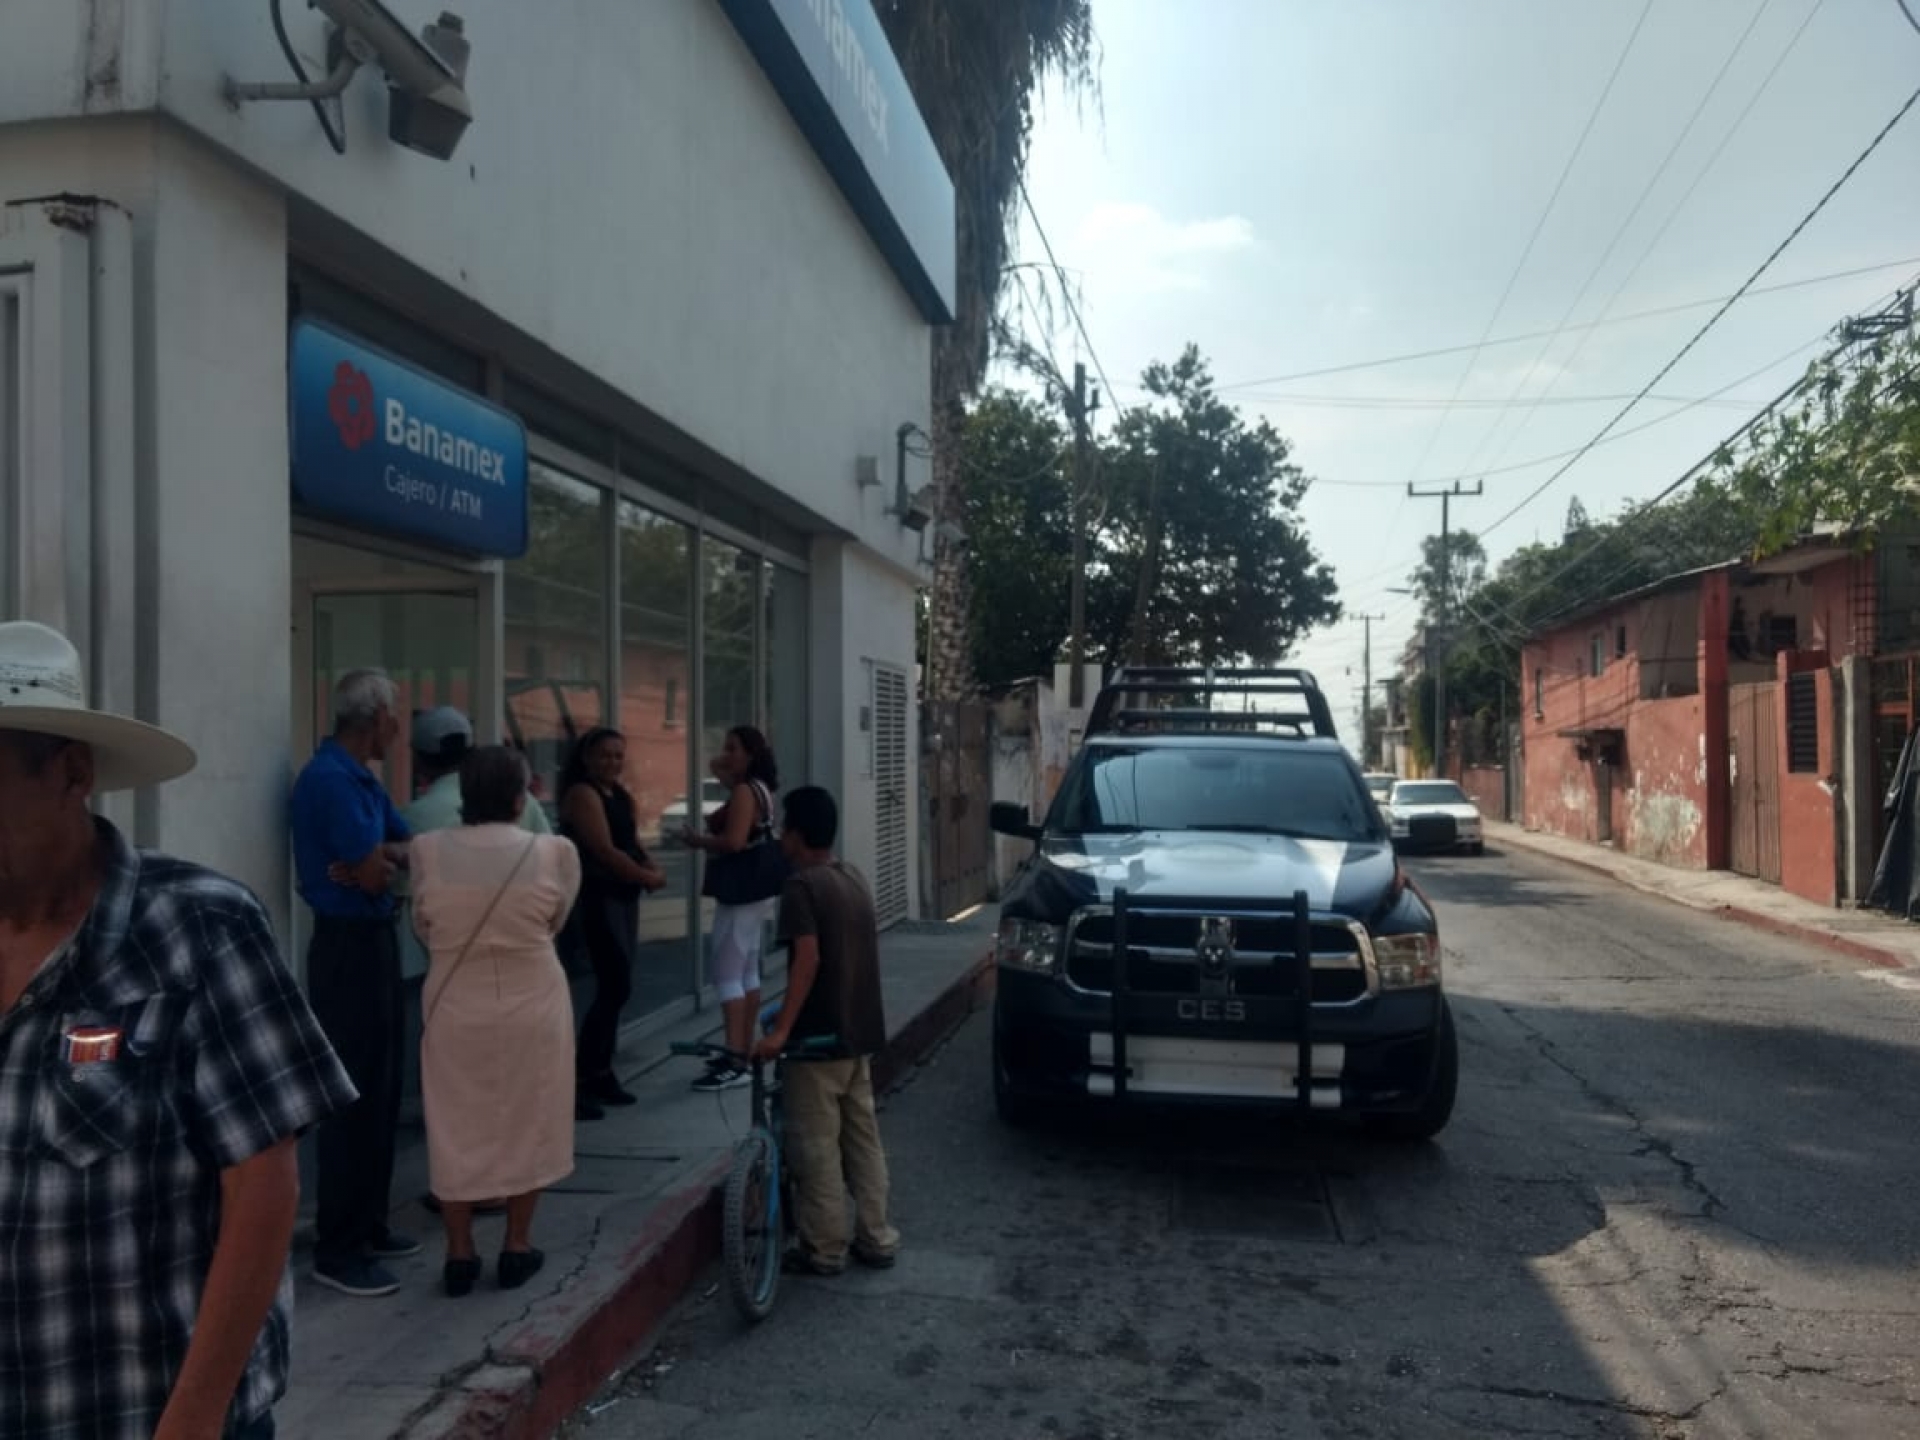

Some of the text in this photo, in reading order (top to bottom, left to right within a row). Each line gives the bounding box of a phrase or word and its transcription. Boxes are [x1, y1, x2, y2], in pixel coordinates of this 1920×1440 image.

[385, 398, 506, 486] Banamex
[385, 464, 436, 506] Cajero
[450, 487, 483, 520] ATM
[1178, 999, 1246, 1021] CES
